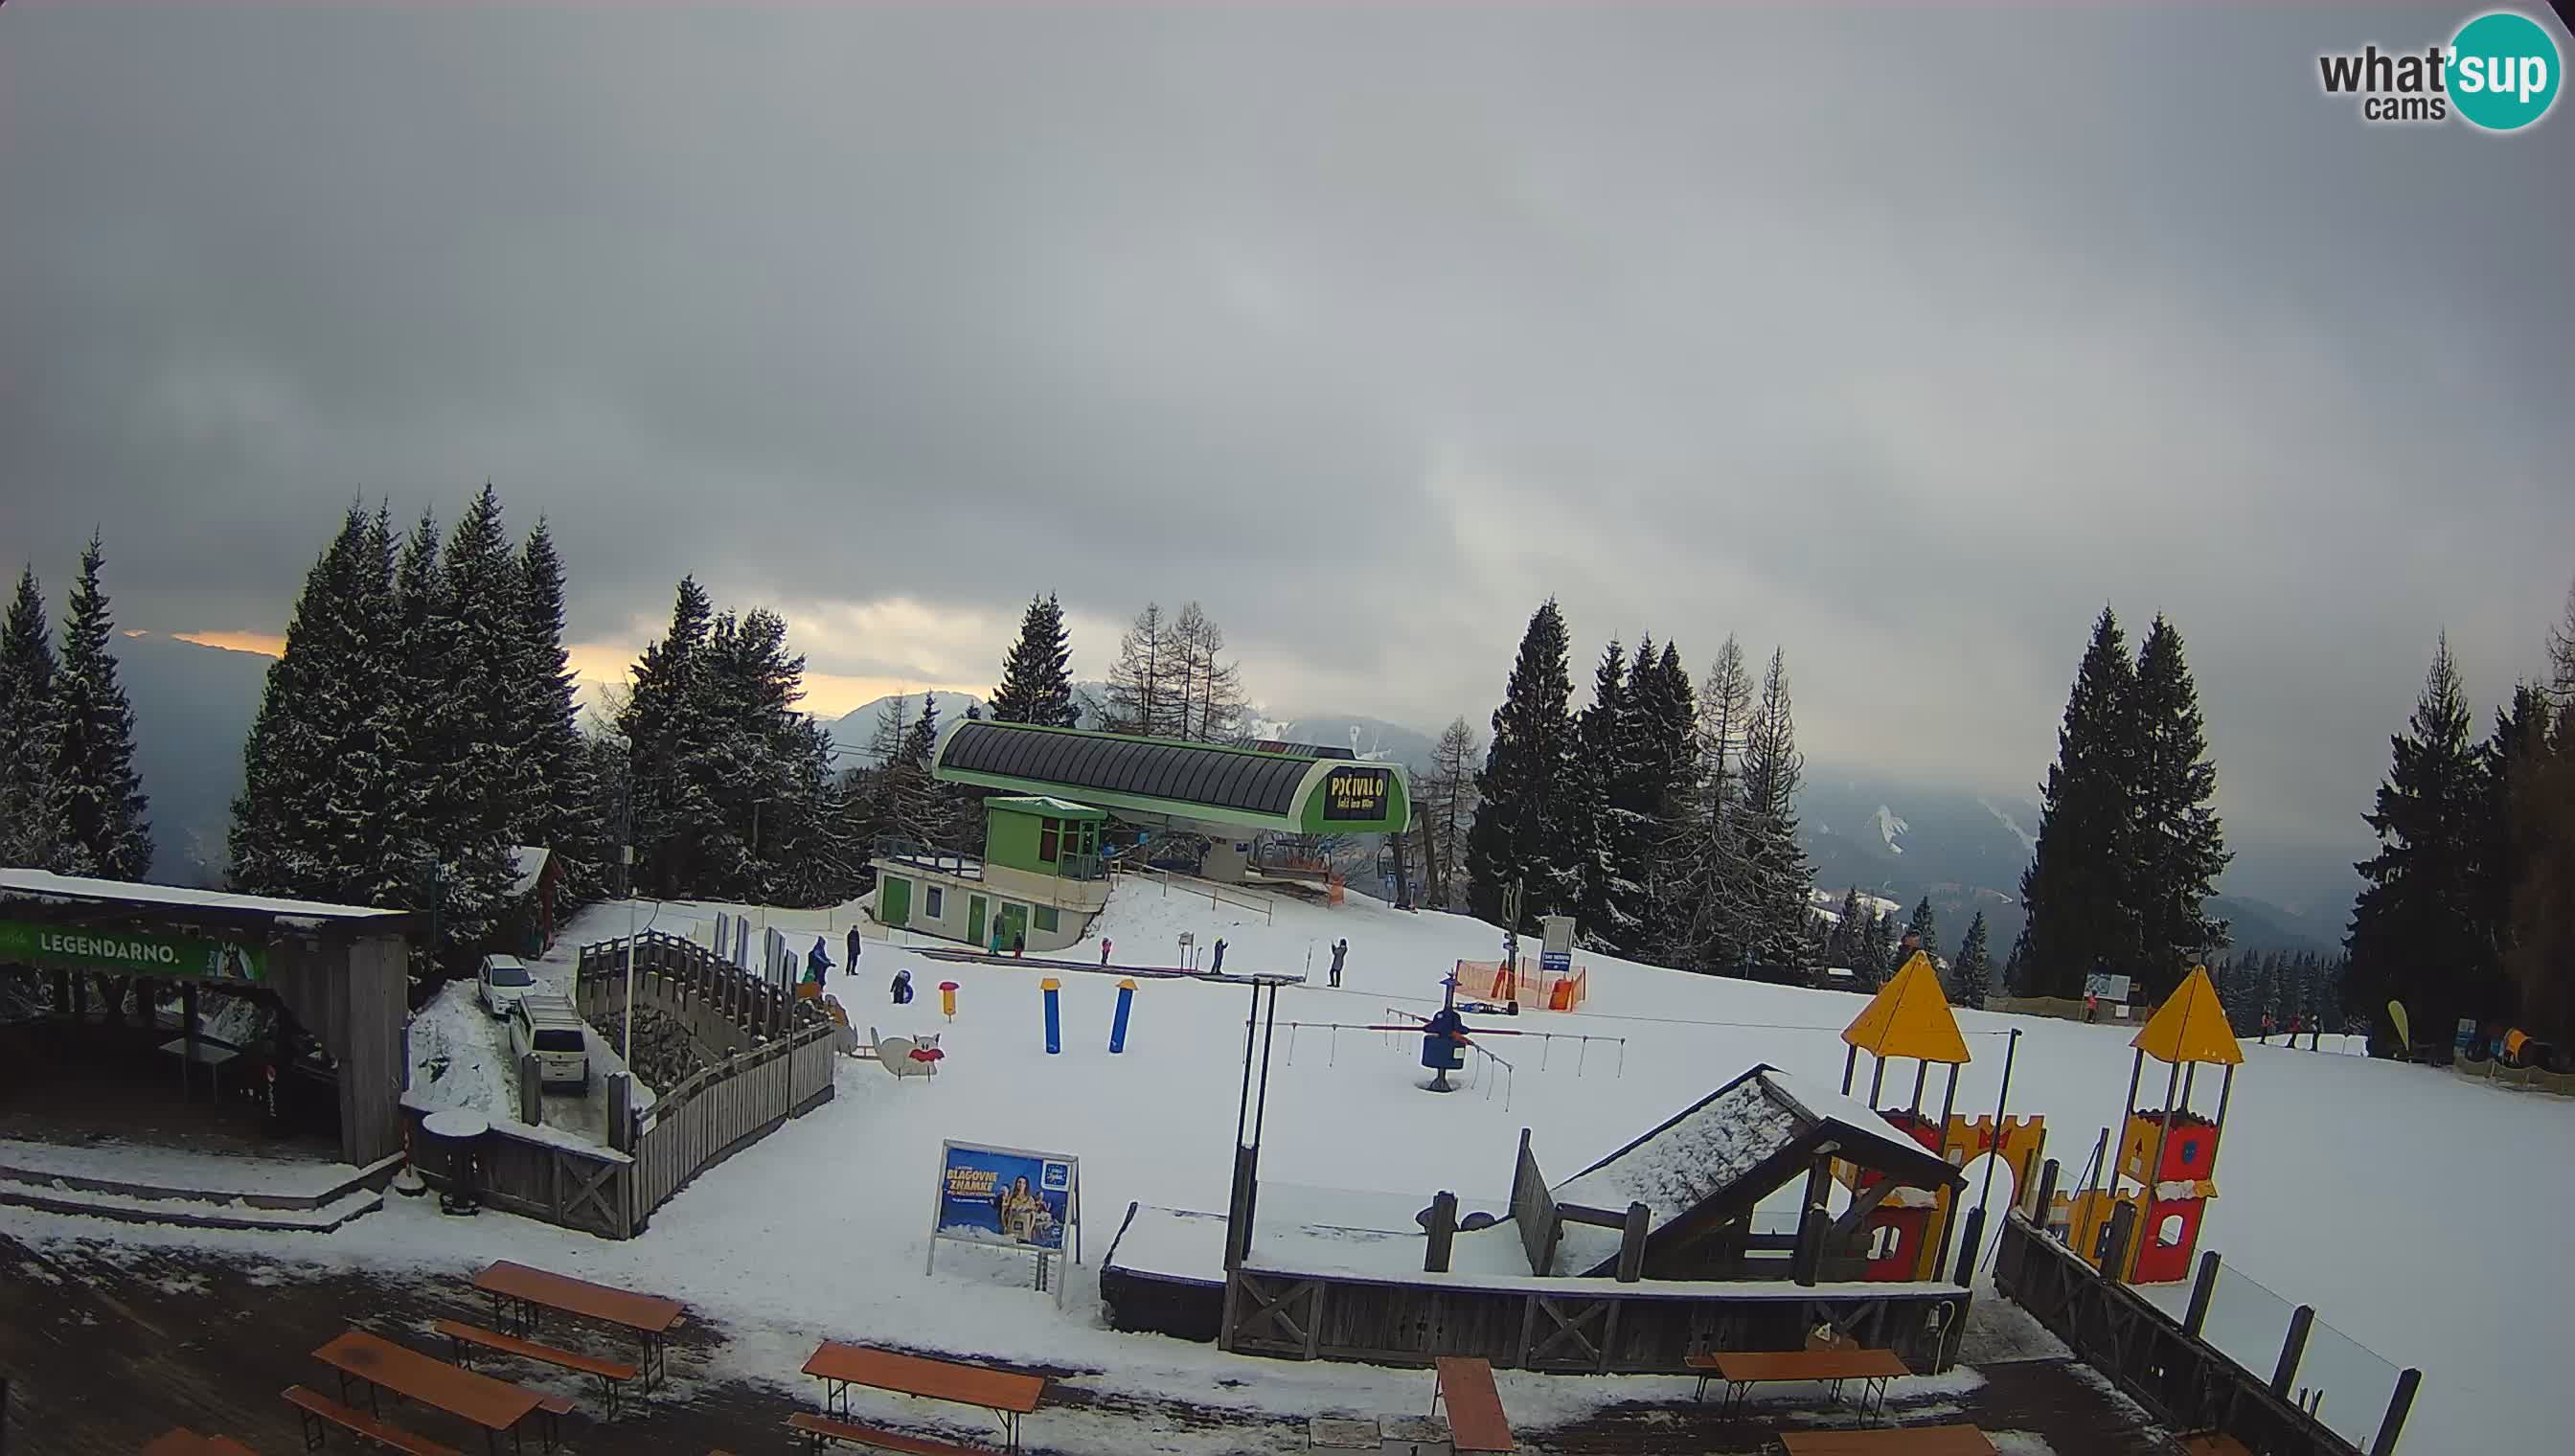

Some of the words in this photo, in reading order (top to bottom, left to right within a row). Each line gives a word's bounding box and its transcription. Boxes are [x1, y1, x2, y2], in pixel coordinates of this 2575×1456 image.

[40, 932, 181, 965] LEGENDARNO.
[946, 1169, 997, 1181] BLAGOVNE
[949, 1179, 993, 1191] ZNAMKE
